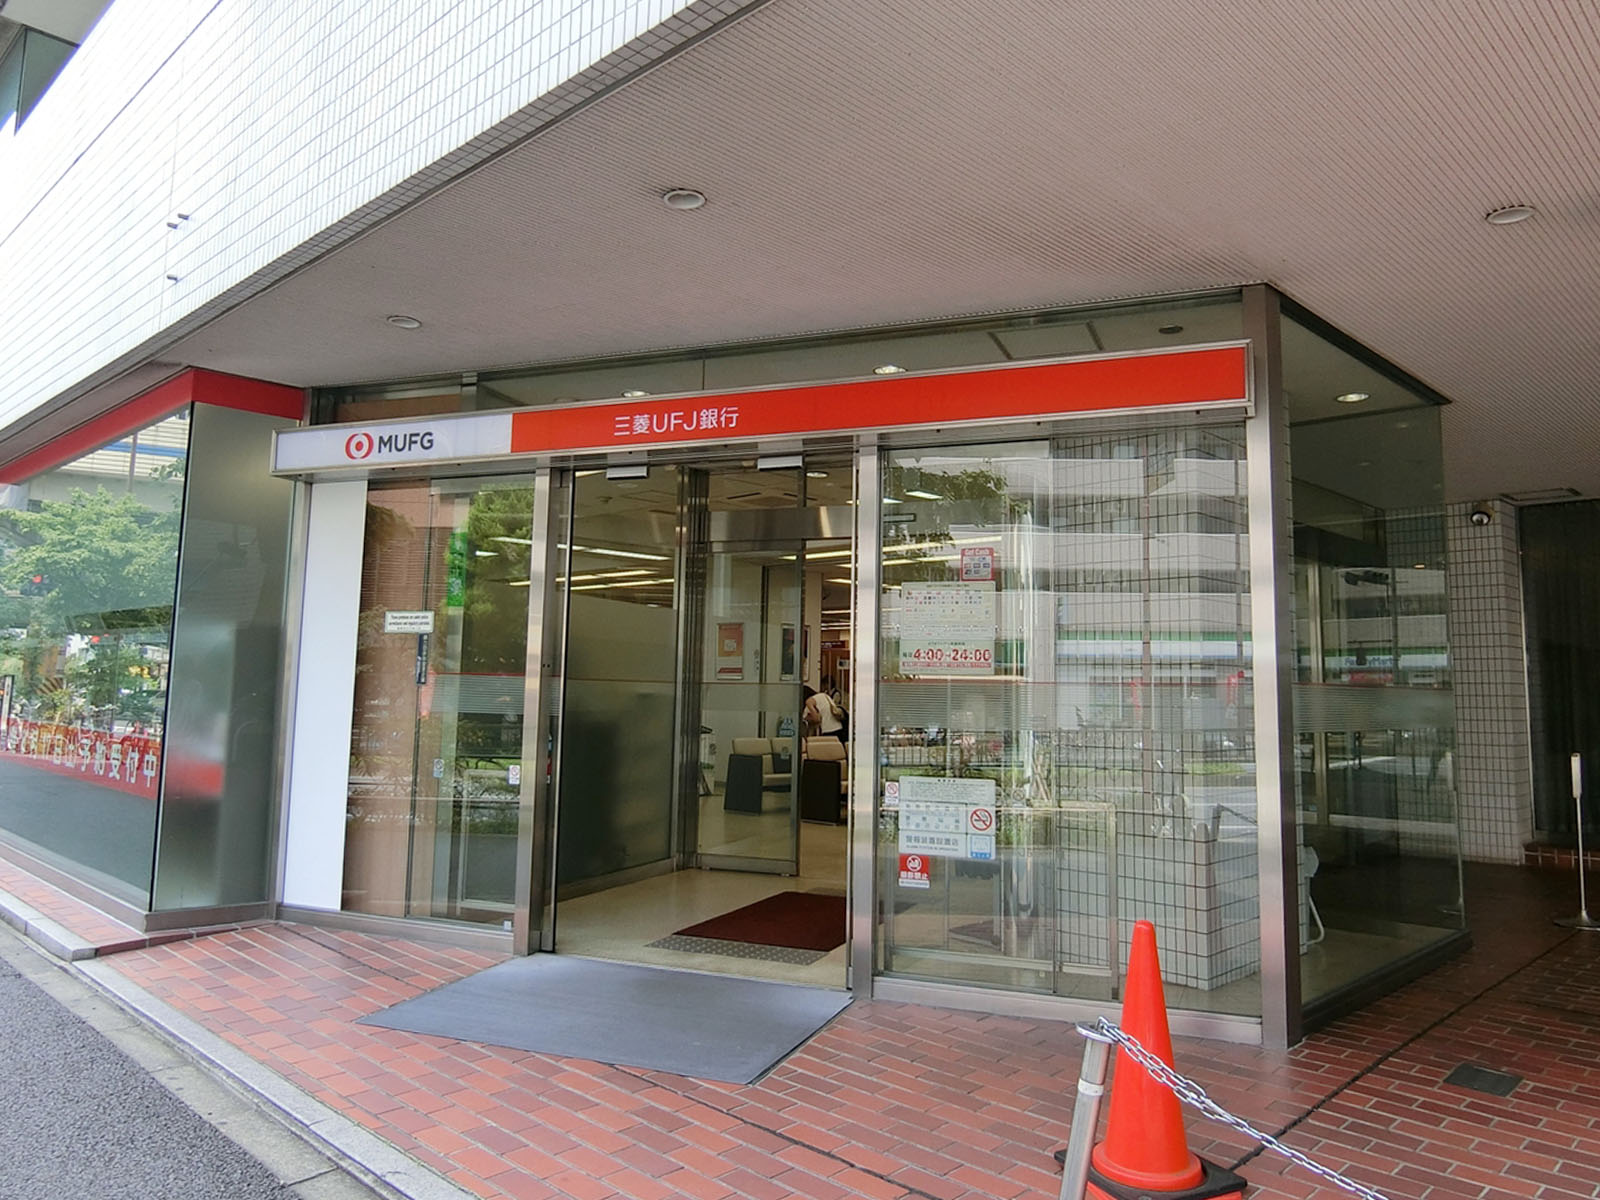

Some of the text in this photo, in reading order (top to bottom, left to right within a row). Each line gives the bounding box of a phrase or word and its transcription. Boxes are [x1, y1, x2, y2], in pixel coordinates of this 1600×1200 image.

[613, 406, 739, 436] 三菱UFJ銀行
[377, 431, 434, 454] MUFG
